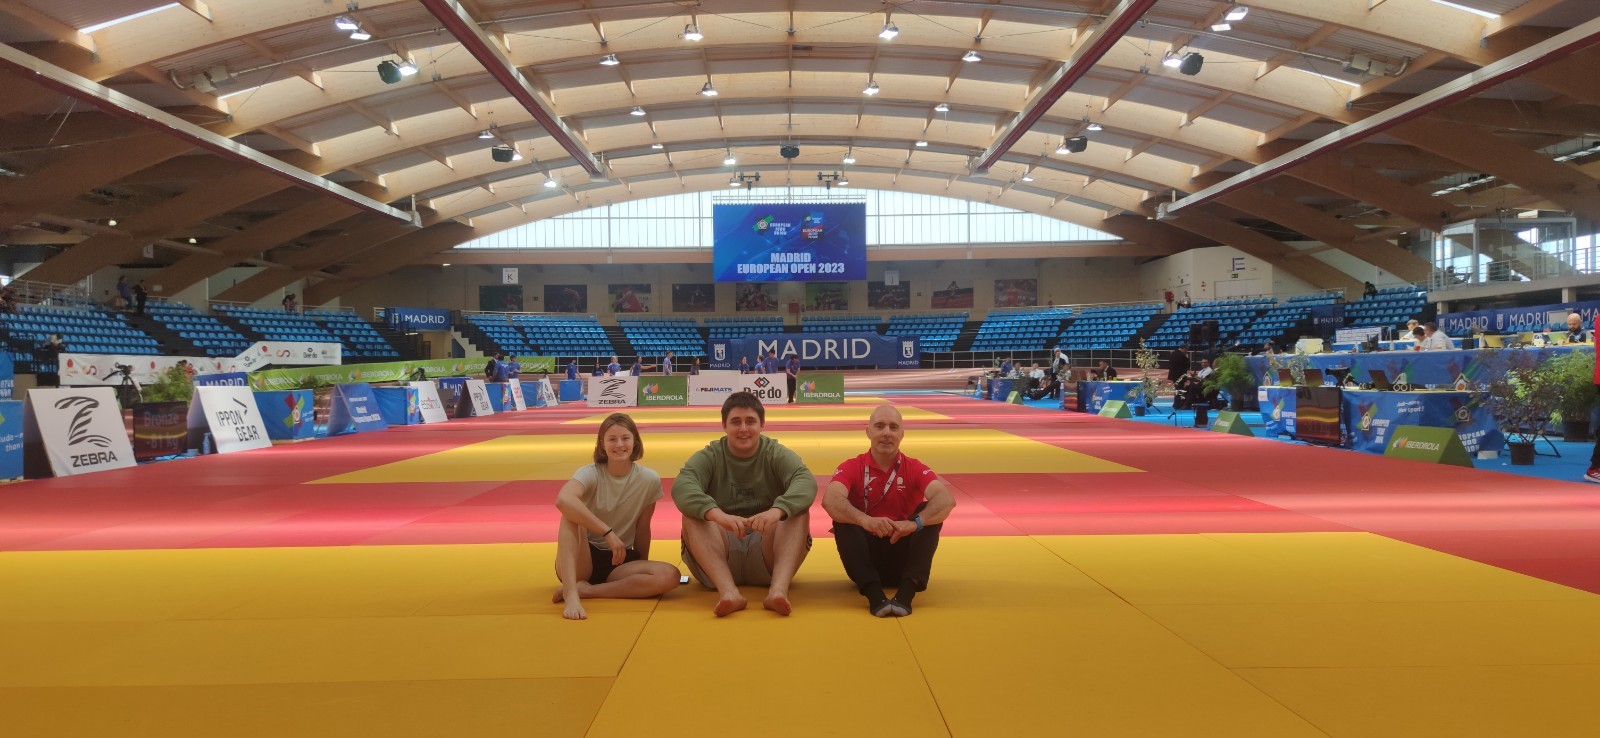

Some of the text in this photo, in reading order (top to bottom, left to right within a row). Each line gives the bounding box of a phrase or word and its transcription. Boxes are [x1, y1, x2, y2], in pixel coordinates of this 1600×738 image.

[770, 252, 812, 263] MADRID
[737, 262, 845, 274] EUROPEAN OPEN 2023
[405, 314, 445, 324] MADRID
[1450, 315, 1489, 330] MADRID
[758, 338, 871, 361] MADRID
[767, 386, 782, 399] do
[143, 411, 180, 426] Bronze
[215, 409, 244, 427] IPPON
[235, 424, 260, 442] GEAR
[1405, 440, 1440, 451] IBERDROLA
[70, 450, 118, 468] ZEBRA
